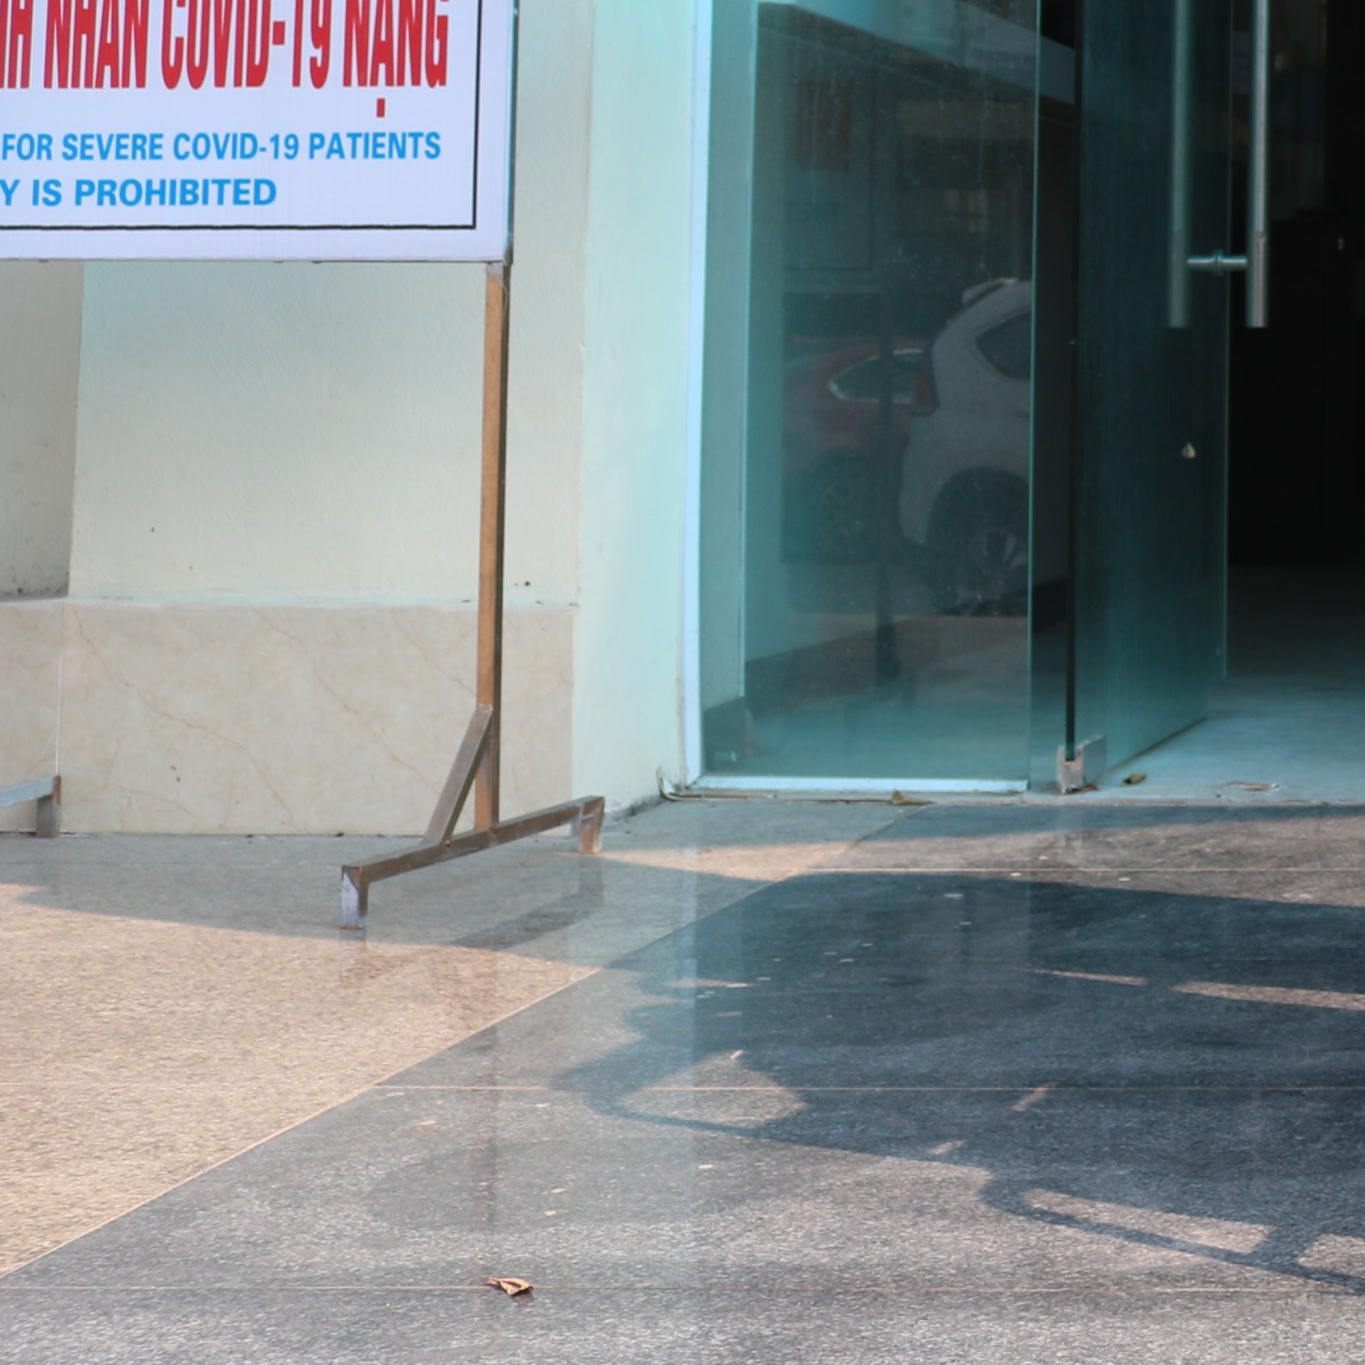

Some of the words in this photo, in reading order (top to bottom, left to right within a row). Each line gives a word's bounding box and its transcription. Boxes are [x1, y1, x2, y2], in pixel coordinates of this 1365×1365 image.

[1, 133, 53, 161] FOR
[62, 132, 164, 161] SEVERE
[173, 132, 300, 161] COVID-19
[308, 131, 441, 160] PATIENTS
[0, 179, 21, 206] Y
[32, 178, 62, 207] IS
[75, 178, 277, 207] PROHIBITED
